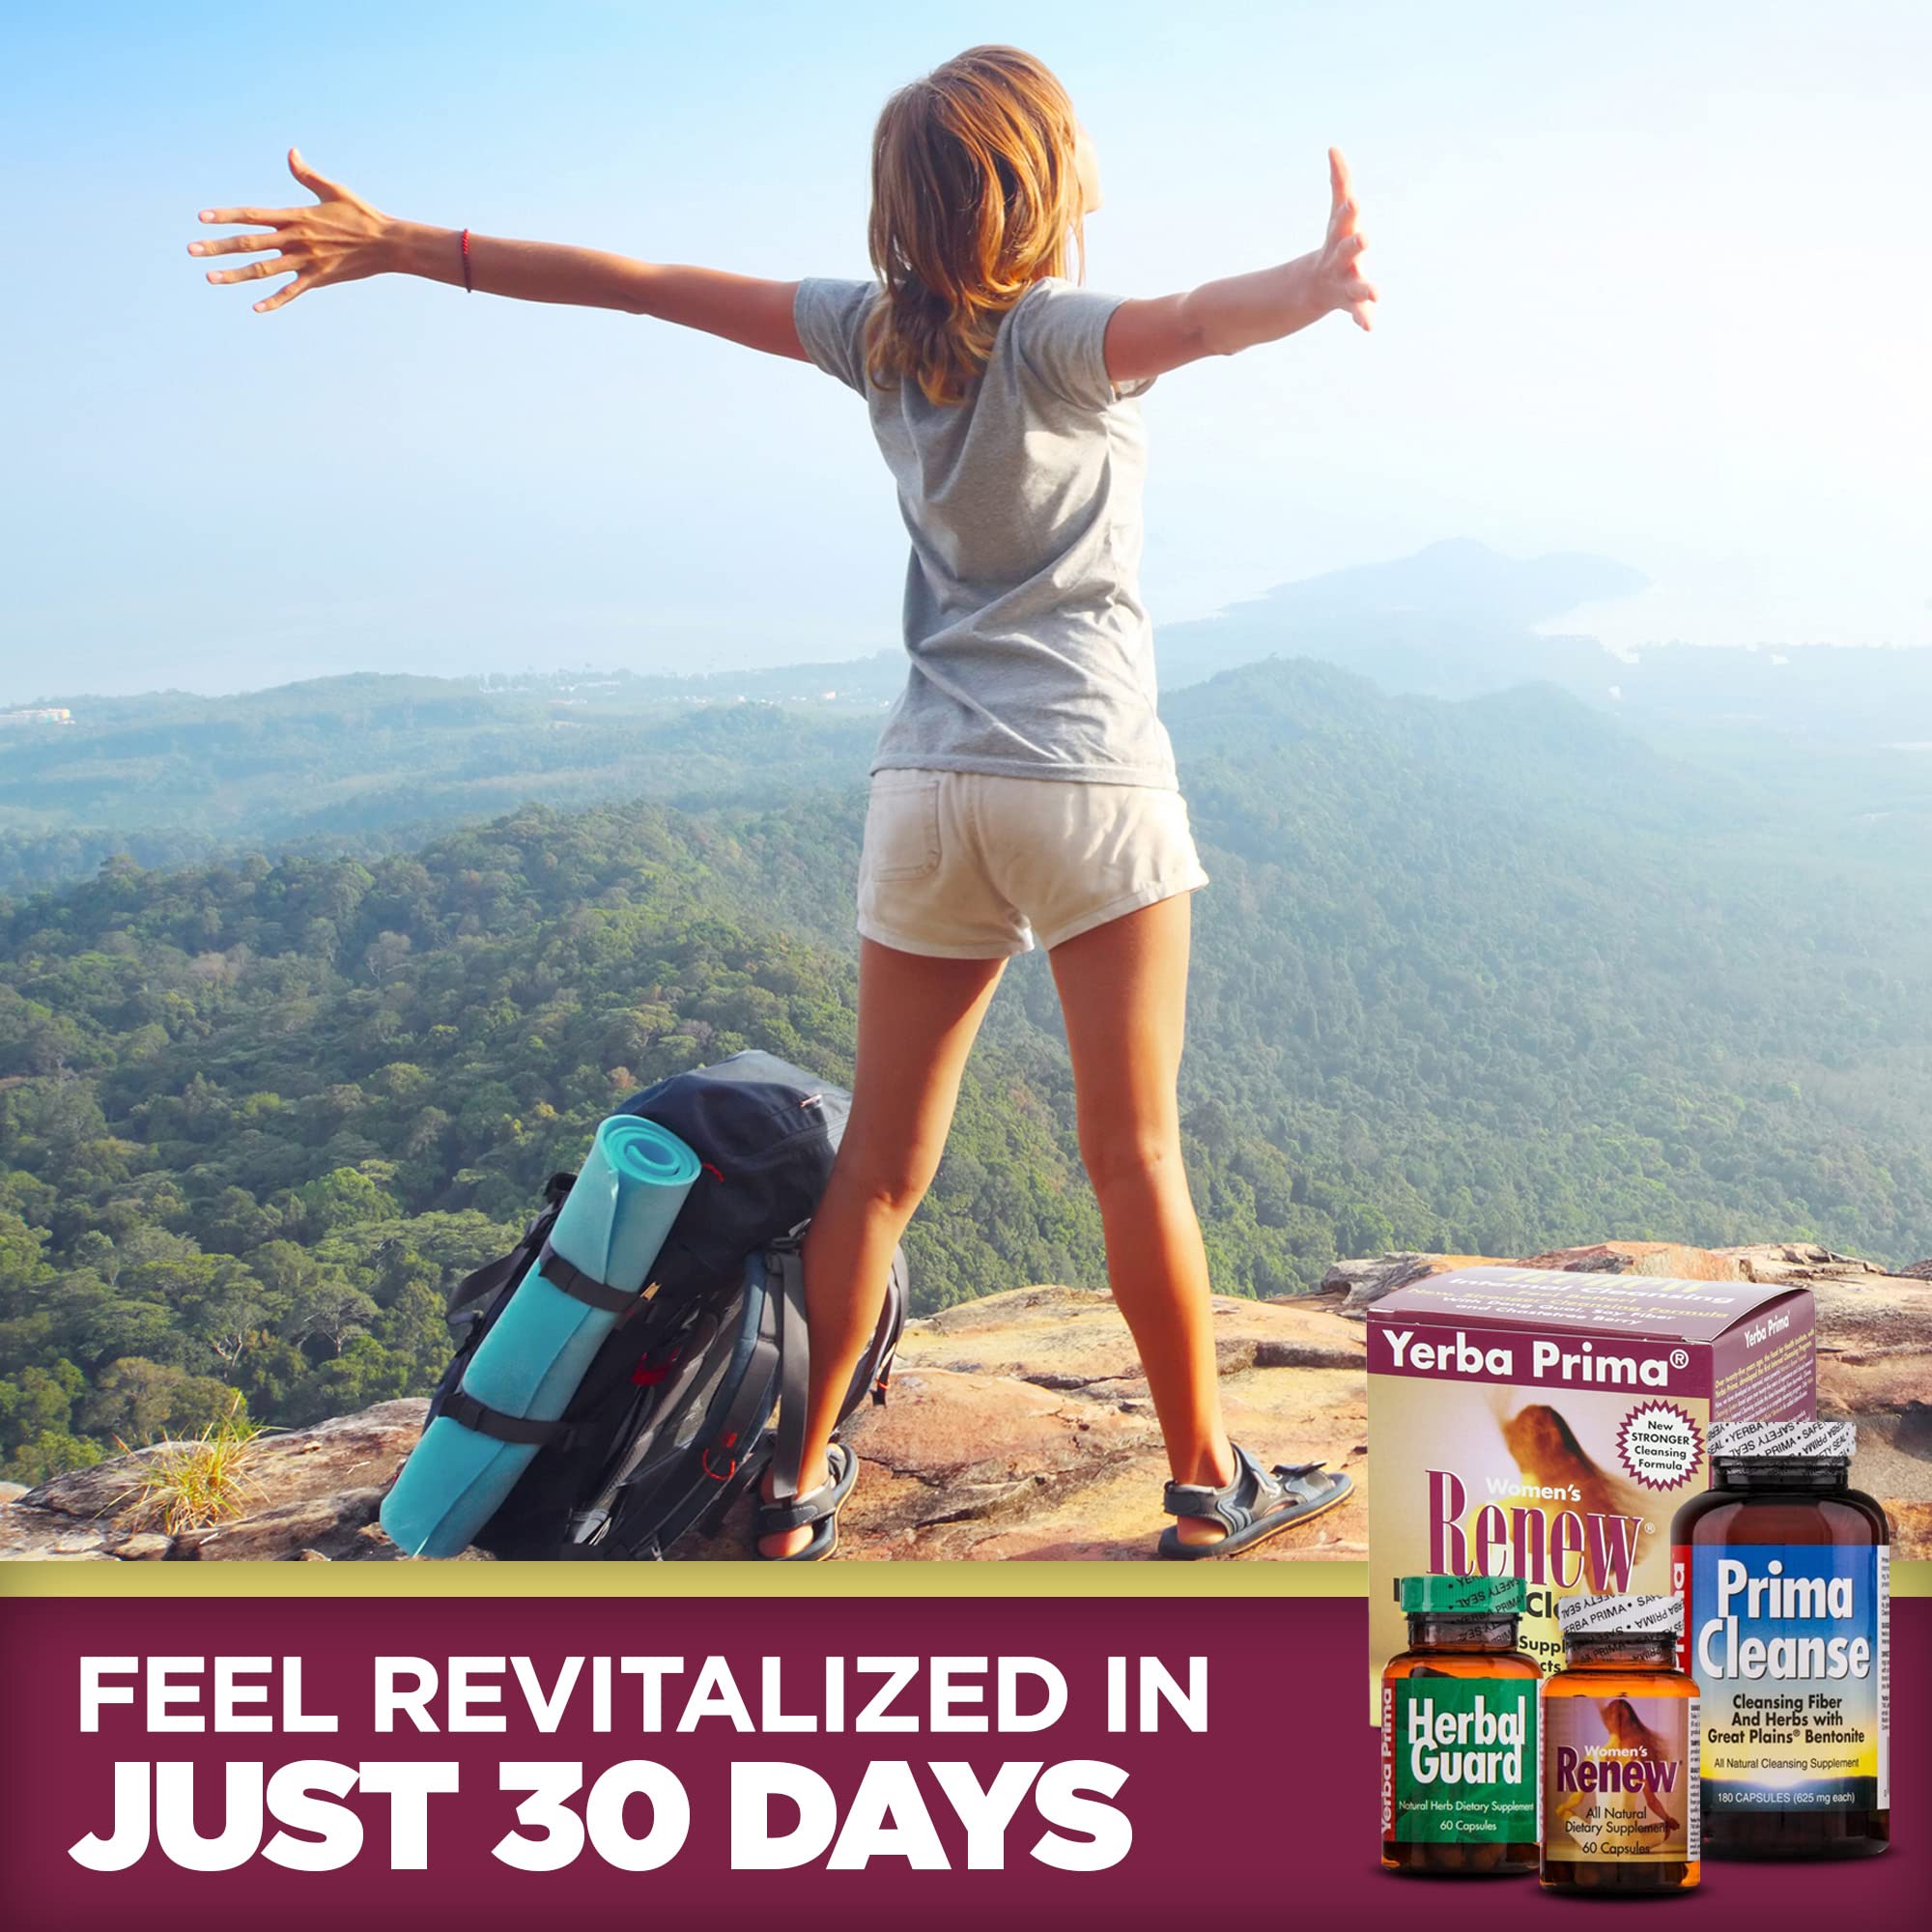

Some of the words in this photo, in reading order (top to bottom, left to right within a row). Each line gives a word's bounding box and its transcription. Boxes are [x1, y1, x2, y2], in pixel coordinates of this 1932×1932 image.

[1449, 1278, 1573, 1291] Internal
[1580, 1287, 1736, 1304] Cleansing
[1745, 1324, 1767, 1349] Yerba
[1768, 1315, 1790, 1337] Prima
[1382, 1329, 1513, 1376] Yerba
[1648, 1420, 1673, 1431] New
[1632, 1432, 1690, 1445] STRONGER
[1634, 1445, 1687, 1461] Cleansing
[1638, 1459, 1683, 1470] Formula
[1486, 1477, 1581, 1502] Women's
[1718, 1559, 1854, 1619] Prima
[1590, 1605, 1627, 1624] PRIMA
[1634, 1609, 1668, 1629] PRIMA
[1697, 1615, 1871, 1680] Cleanse
[1732, 1693, 1804, 1712] Cleansing
[1808, 1693, 1843, 1709] Fiber
[1381, 1688, 1392, 1758] Prima
[1408, 1695, 1526, 1746] Herbal
[1731, 1711, 1761, 1726] And
[1765, 1711, 1808, 1726] Herbs
[1812, 1711, 1844, 1726] with
[1708, 1728, 1746, 1744] Great
[1804, 1728, 1865, 1744] Bentonite
[1584, 1746, 1648, 1757] Women's
[1410, 1736, 1522, 1785] Guard
[1714, 1758, 1724, 1769] All
[1726, 1758, 1759, 1769] Natural
[1761, 1758, 1807, 1771] Cleansing
[1810, 1758, 1860, 1771] Supplement
[1556, 1746, 1679, 1794] Renew
[1381, 1763, 1392, 1833] Yerba
[1718, 1793, 1733, 1804] 180
[1735, 1793, 1791, 1804] CAPSULES
[1793, 1792, 1814, 1804] (625
[1816, 1795, 1831, 1804] mg
[1833, 1792, 1856, 1804] each)
[1399, 1801, 1429, 1811] Natural
[1431, 1801, 1454, 1811] Herb
[1455, 1801, 1489, 1814] Dietary
[1492, 1801, 1534, 1814] Supplement
[1585, 1806, 1601, 1819] All
[1605, 1806, 1647, 1819] Natural
[1439, 1820, 1453, 1831] 60
[1455, 1820, 1497, 1833] Capsules
[1565, 1821, 1603, 1836] Dietary
[1605, 1821, 1669, 1835] Supplement
[1582, 1842, 1598, 1854] 60
[1600, 1841, 1651, 1857] Capsules
